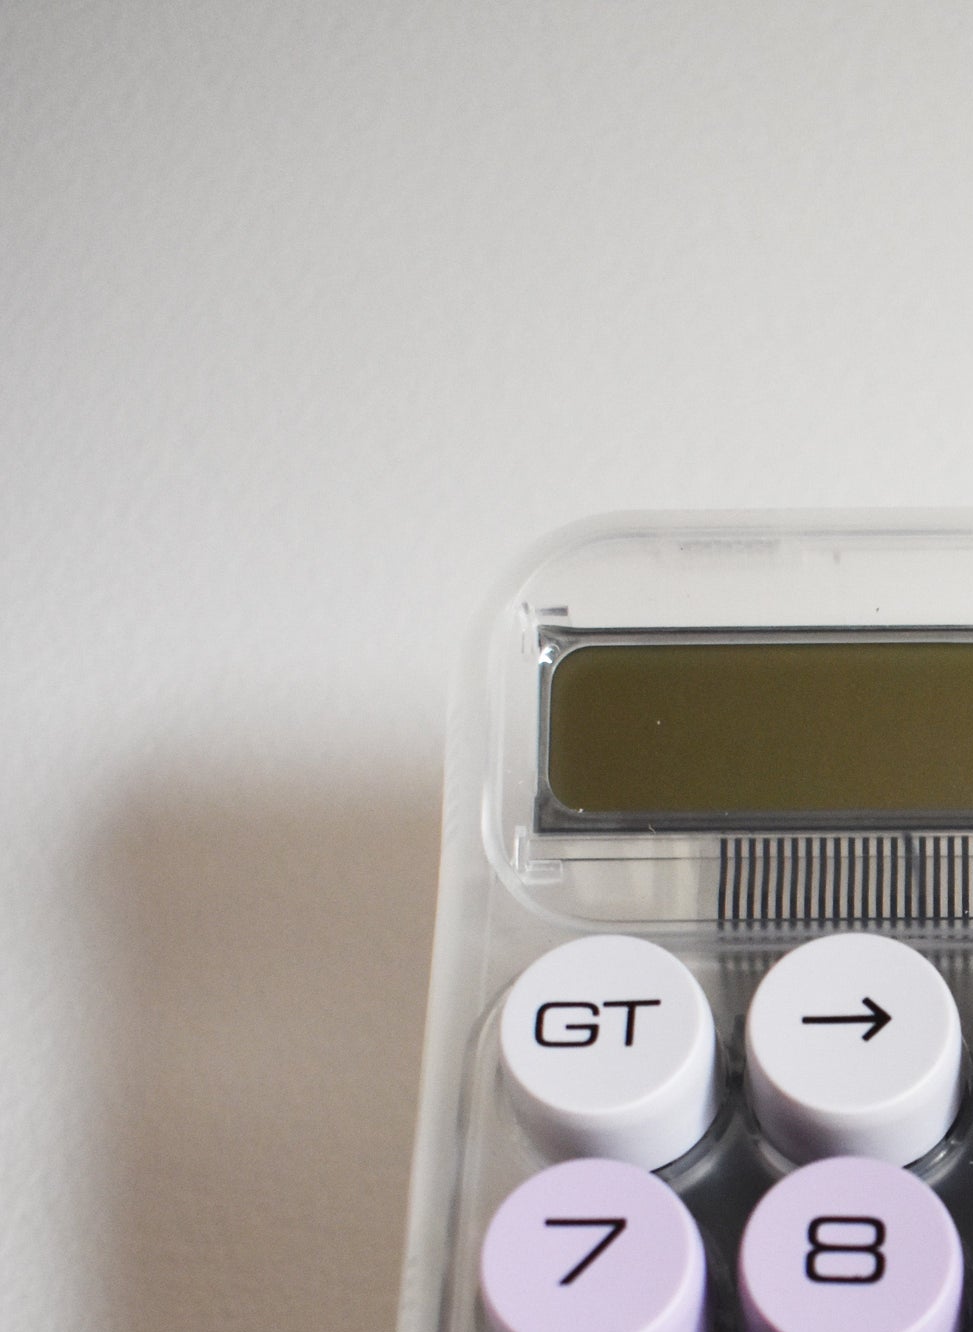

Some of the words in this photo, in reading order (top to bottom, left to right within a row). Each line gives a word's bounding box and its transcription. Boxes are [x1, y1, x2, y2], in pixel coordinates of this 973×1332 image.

[534, 999, 662, 1048] GT
[544, 1217, 628, 1286] 7
[804, 1215, 887, 1285] 8
